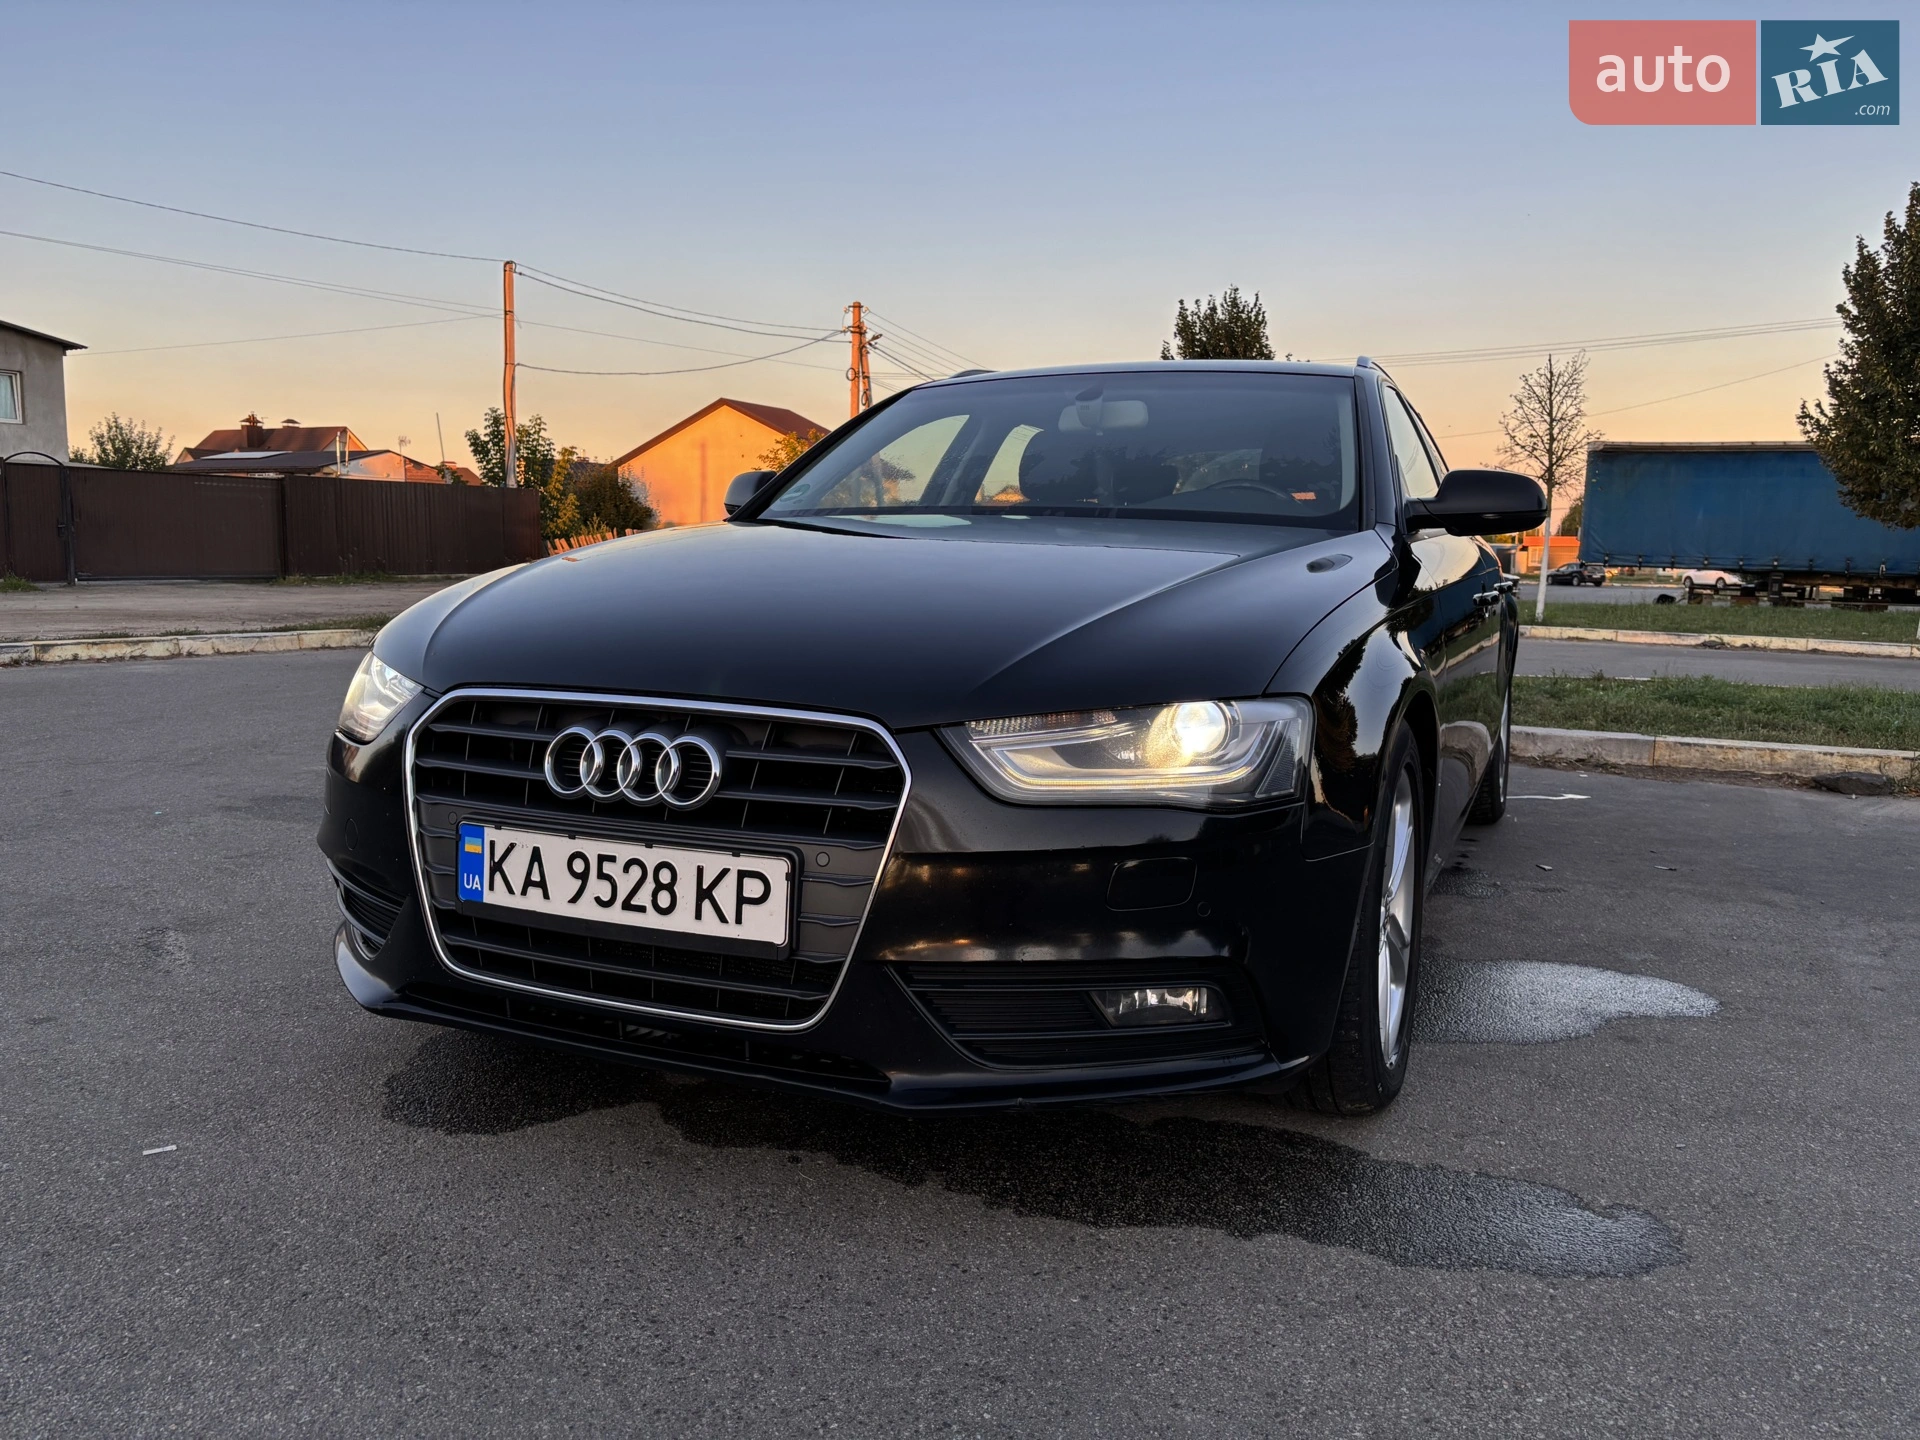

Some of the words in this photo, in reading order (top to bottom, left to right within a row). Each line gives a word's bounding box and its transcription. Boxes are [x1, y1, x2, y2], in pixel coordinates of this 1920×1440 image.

[463, 873, 482, 891] UA
[488, 839, 551, 901] KA
[566, 850, 678, 916] 9528
[694, 864, 772, 925] KP
